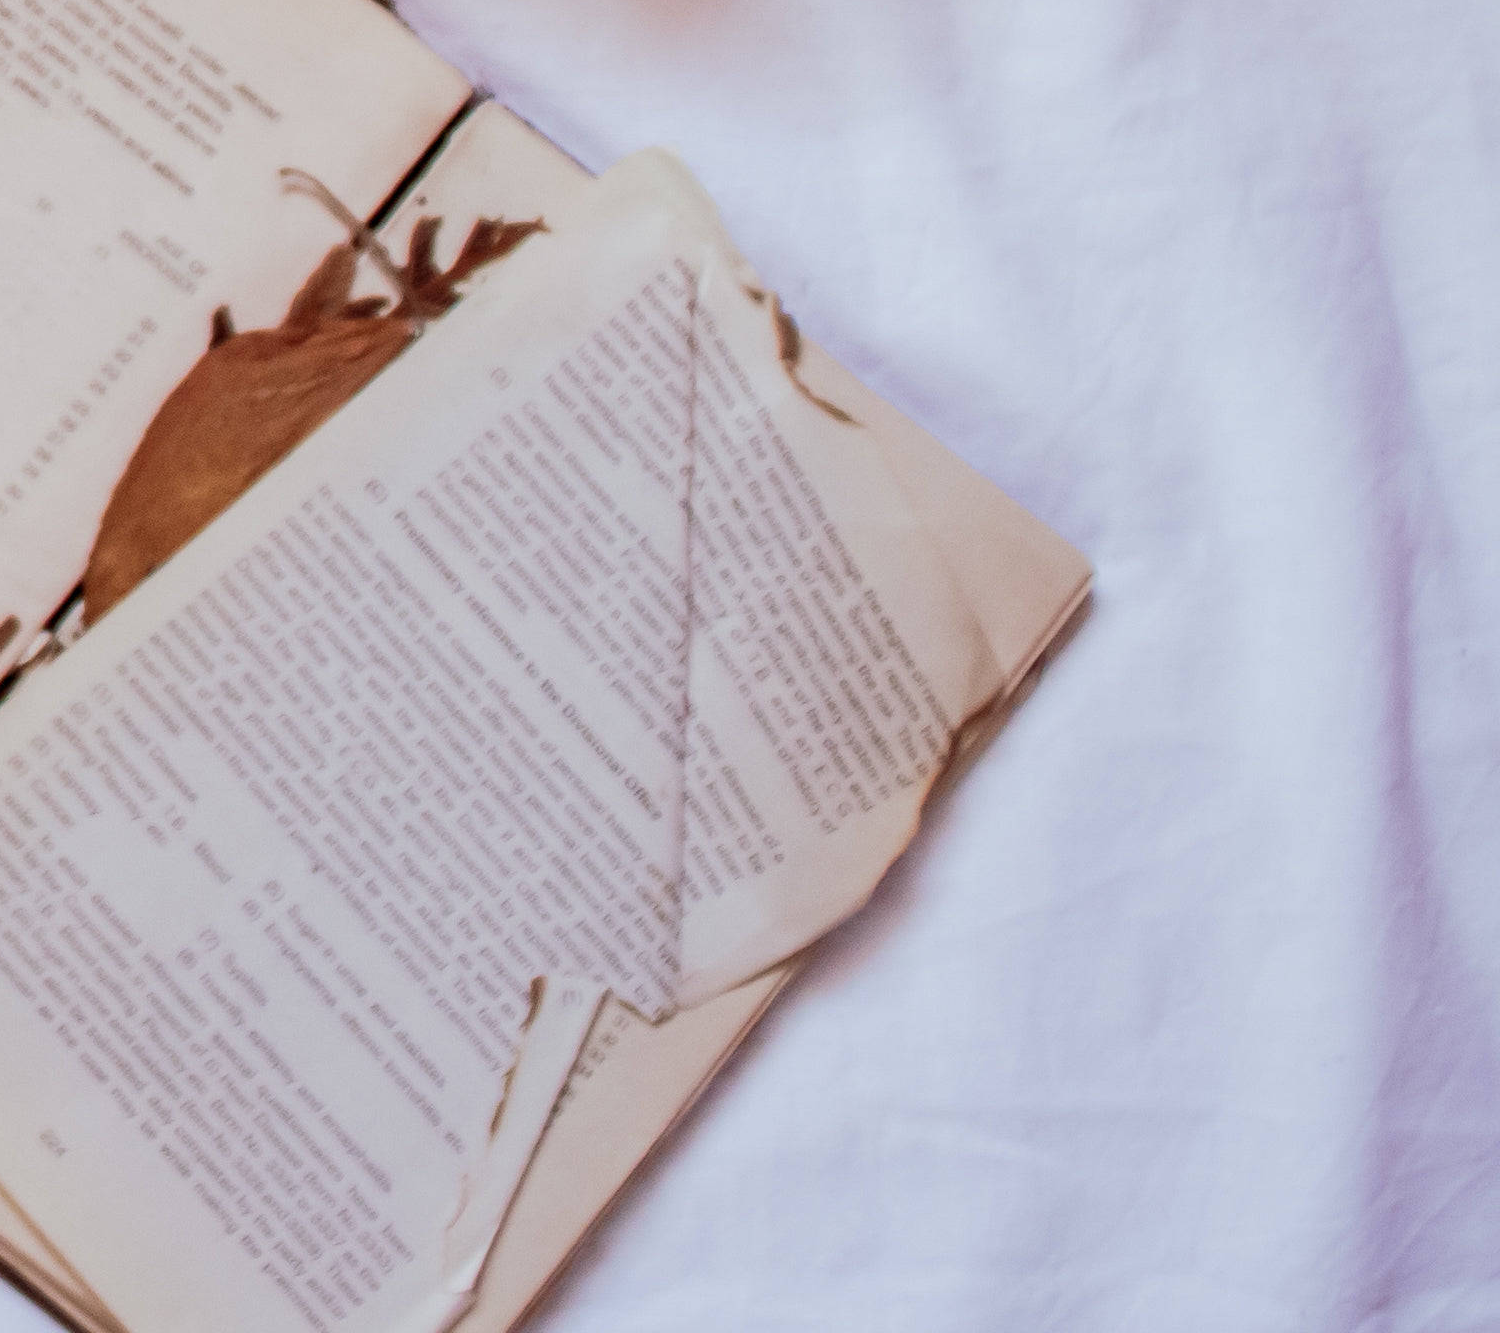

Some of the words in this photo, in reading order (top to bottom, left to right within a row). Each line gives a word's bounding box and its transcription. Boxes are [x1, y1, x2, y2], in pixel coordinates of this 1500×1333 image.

[388, 508, 469, 597] Preliminary
[461, 591, 529, 665] reference
[521, 658, 543, 681] to
[536, 676, 567, 707] the
[558, 701, 629, 779] Divisional
[620, 772, 667, 823] Office
[357, 701, 420, 770] reference
[415, 767, 438, 790] to
[431, 785, 459, 814] the
[453, 811, 519, 883] Divisional
[511, 878, 557, 927] Office
